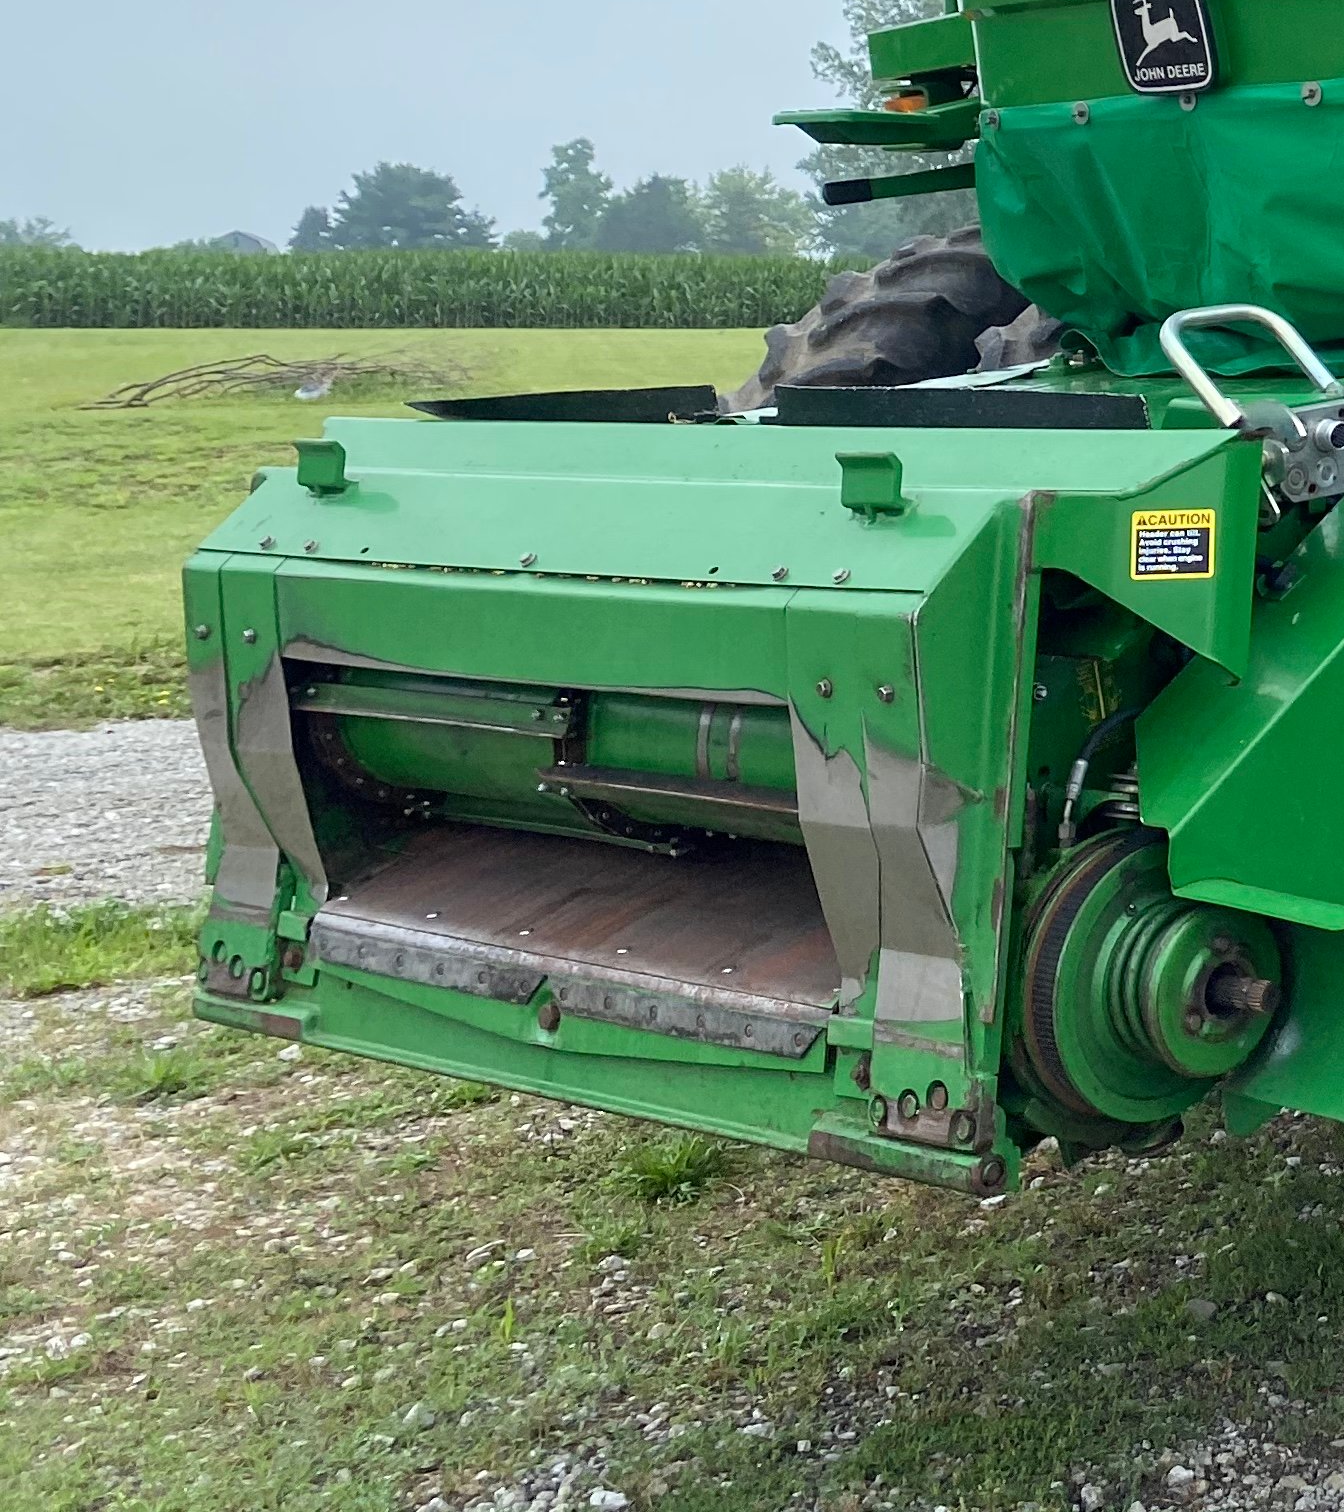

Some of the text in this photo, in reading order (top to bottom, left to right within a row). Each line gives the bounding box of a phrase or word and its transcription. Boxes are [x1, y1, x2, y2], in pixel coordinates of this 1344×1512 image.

[1134, 62, 1206, 82] JOHN DEERE
[1148, 513, 1211, 525] CAUTION
[1139, 530, 1169, 538] Header
[1138, 538, 1199, 547] Avoid crushing
